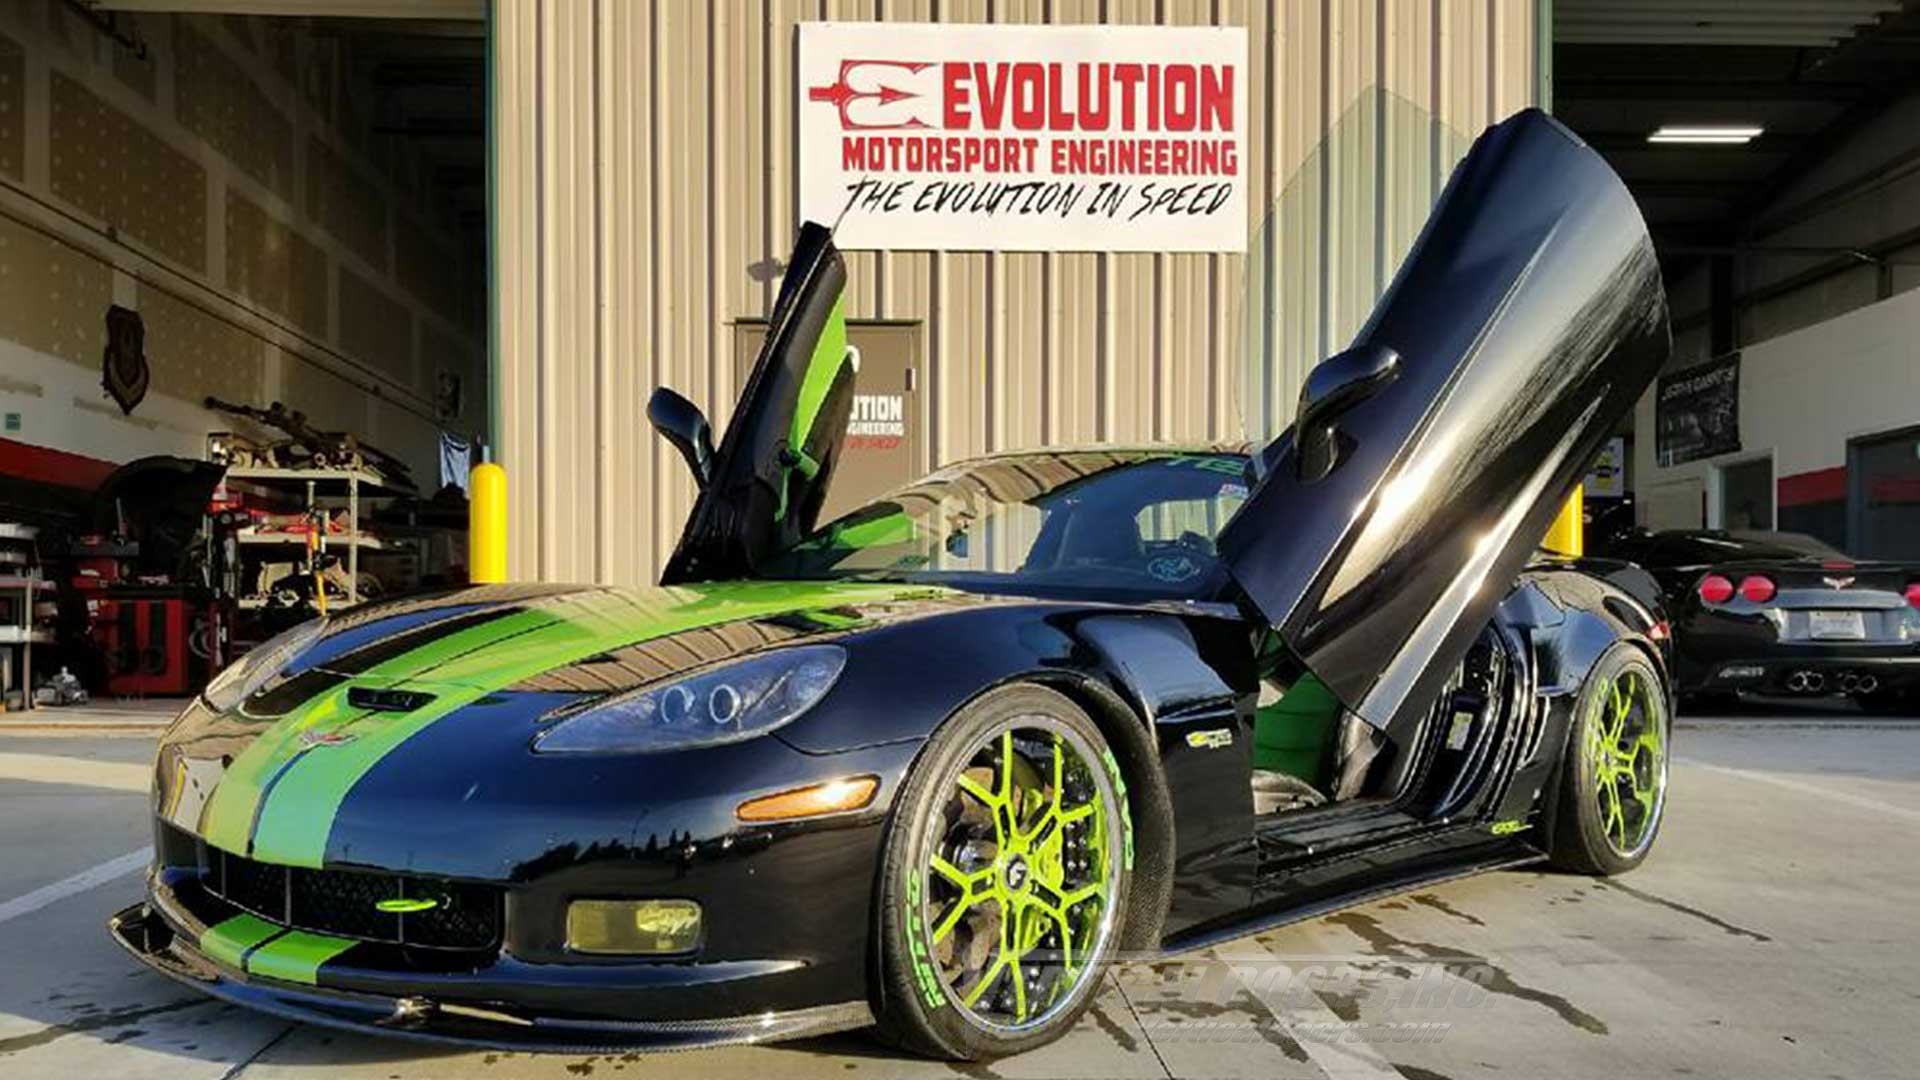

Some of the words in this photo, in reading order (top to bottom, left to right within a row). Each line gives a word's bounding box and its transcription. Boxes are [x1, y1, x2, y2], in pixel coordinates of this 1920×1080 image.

[943, 62, 1234, 132] EVOLUTION
[842, 136, 1039, 173] MOTORSPORT
[1051, 139, 1238, 176] ENGINEERING
[846, 177, 914, 214] THE
[913, 181, 1085, 219] EVOLUTION
[1086, 182, 1132, 218] IN
[1128, 183, 1233, 221] SPEED
